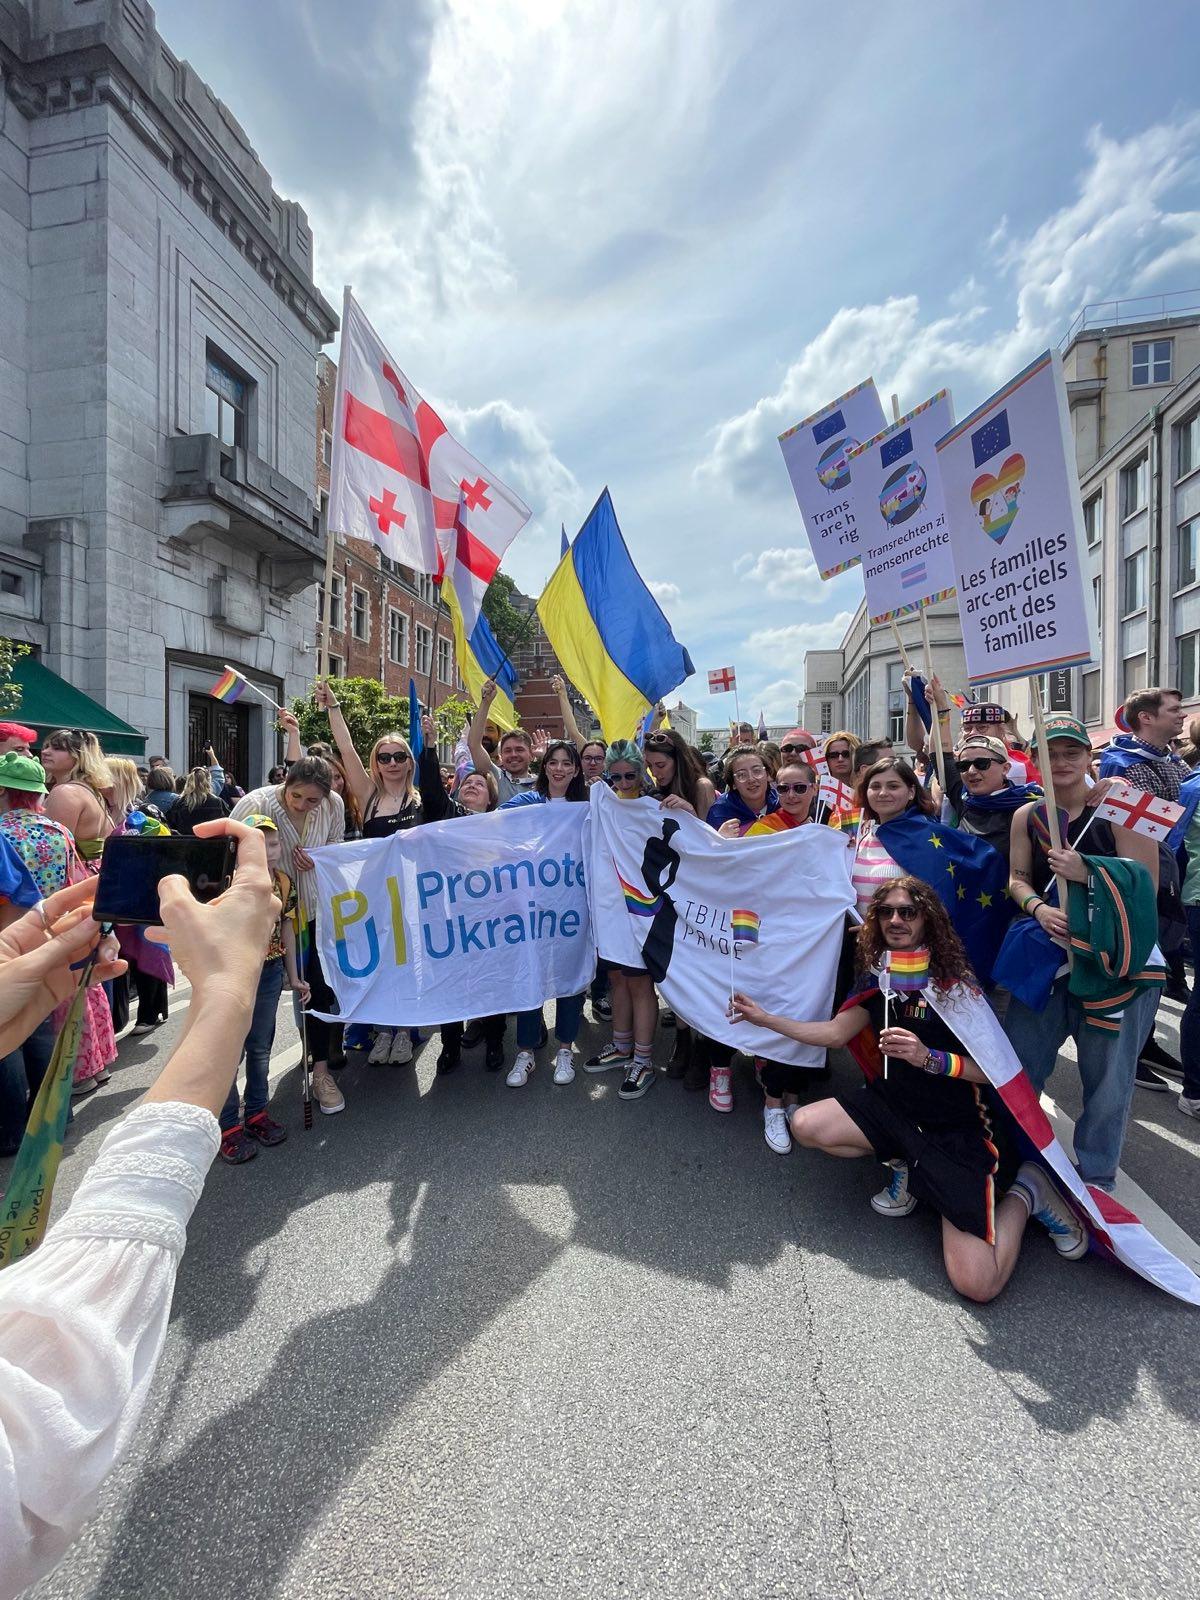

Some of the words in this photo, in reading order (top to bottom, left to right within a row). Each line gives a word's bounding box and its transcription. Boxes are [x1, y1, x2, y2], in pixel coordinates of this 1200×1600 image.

[811, 500, 850, 525] Trans
[820, 521, 843, 538] are
[839, 528, 860, 544] rig
[866, 533, 950, 578] mensenrechte
[867, 521, 933, 559] Transrechten
[935, 513, 946, 527] zi
[961, 569, 987, 592] Les
[990, 533, 1067, 579] familles
[967, 560, 1068, 613] arc-en-ciels
[980, 604, 1017, 632] sont
[1022, 593, 1056, 618] des
[985, 620, 1057, 653] familles
[423, 900, 580, 959] Ukraine
[683, 923, 742, 960] PRIDE
